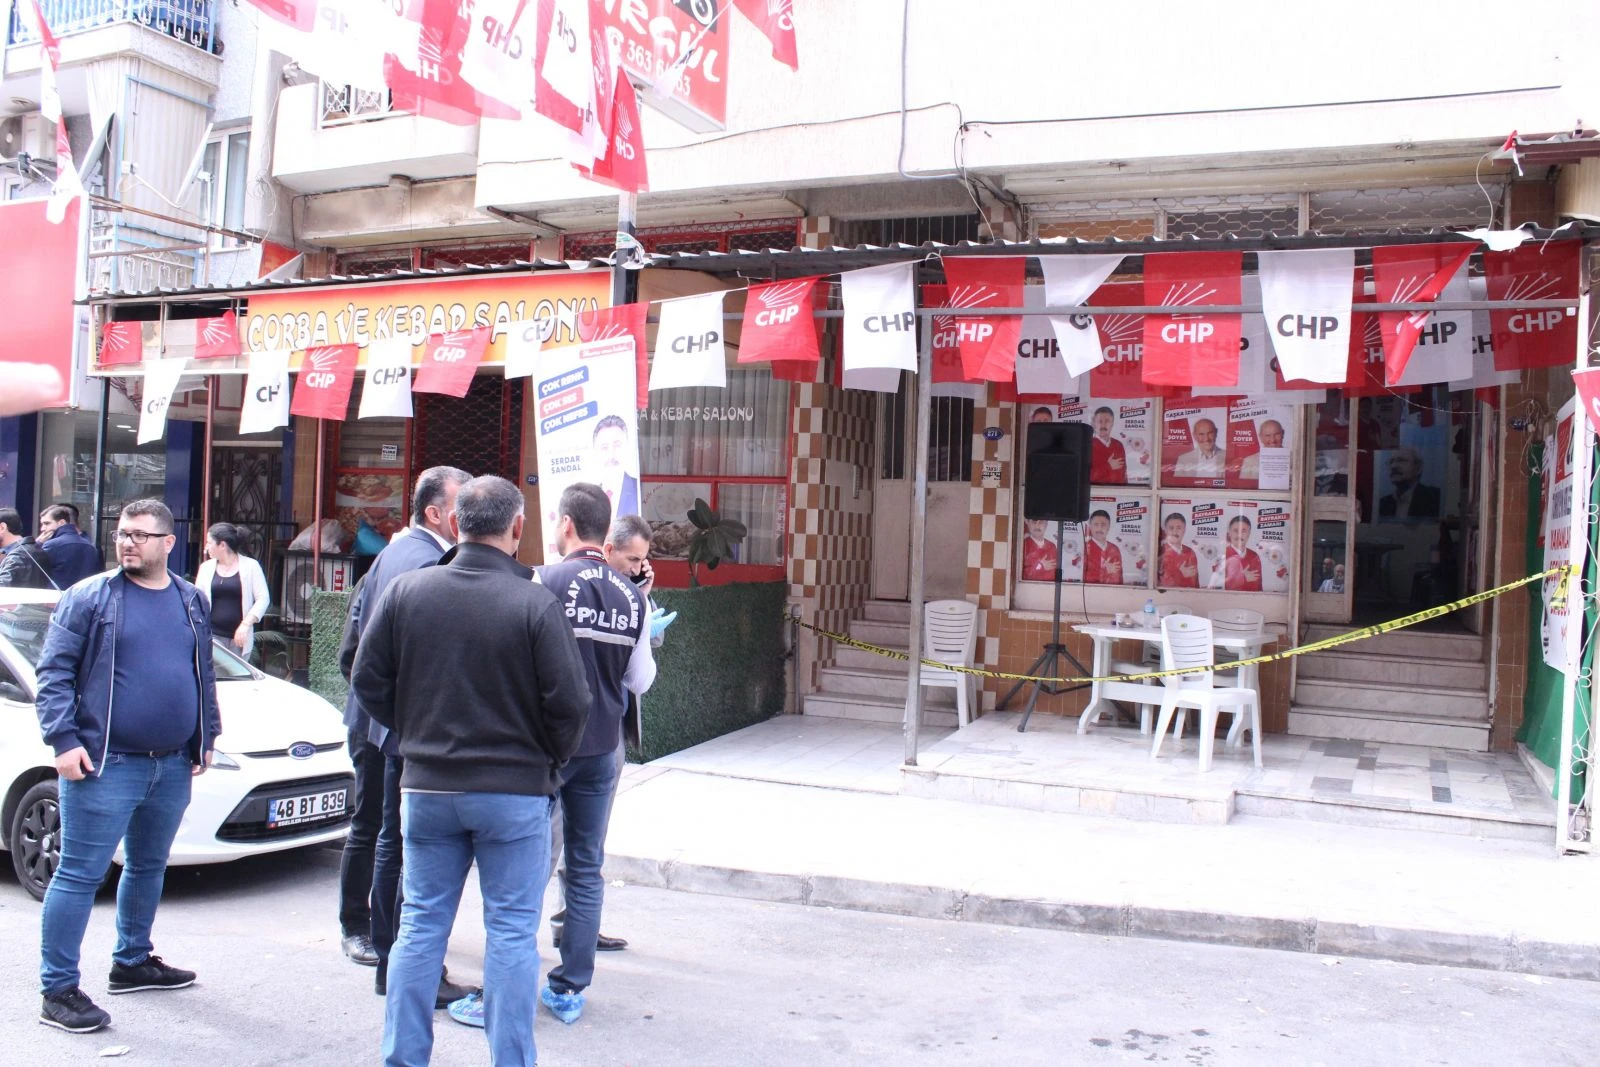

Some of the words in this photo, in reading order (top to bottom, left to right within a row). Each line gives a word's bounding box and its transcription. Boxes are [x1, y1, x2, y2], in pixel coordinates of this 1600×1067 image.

[335, 303, 370, 348] VE
[755, 304, 799, 327] CHP
[863, 311, 915, 333] CHP
[1277, 313, 1339, 340] CHP
[1508, 310, 1563, 334] CHP
[671, 331, 719, 354] CHP
[955, 323, 993, 343] HP
[1161, 322, 1214, 344] CHP
[1419, 320, 1458, 346] HP
[433, 346, 467, 363] CHP
[306, 372, 336, 389] CHP
[373, 365, 407, 386] CHP
[660, 406, 701, 421] KEBAP
[702, 406, 755, 421] SALONU
[551, 455, 581, 466] SERDAR
[551, 464, 582, 475] SANDAL
[565, 580, 581, 618] OLAY
[577, 606, 629, 631] POLİS
[276, 799, 295, 819] 48
[300, 796, 317, 815] BT
[321, 791, 345, 811] 839
